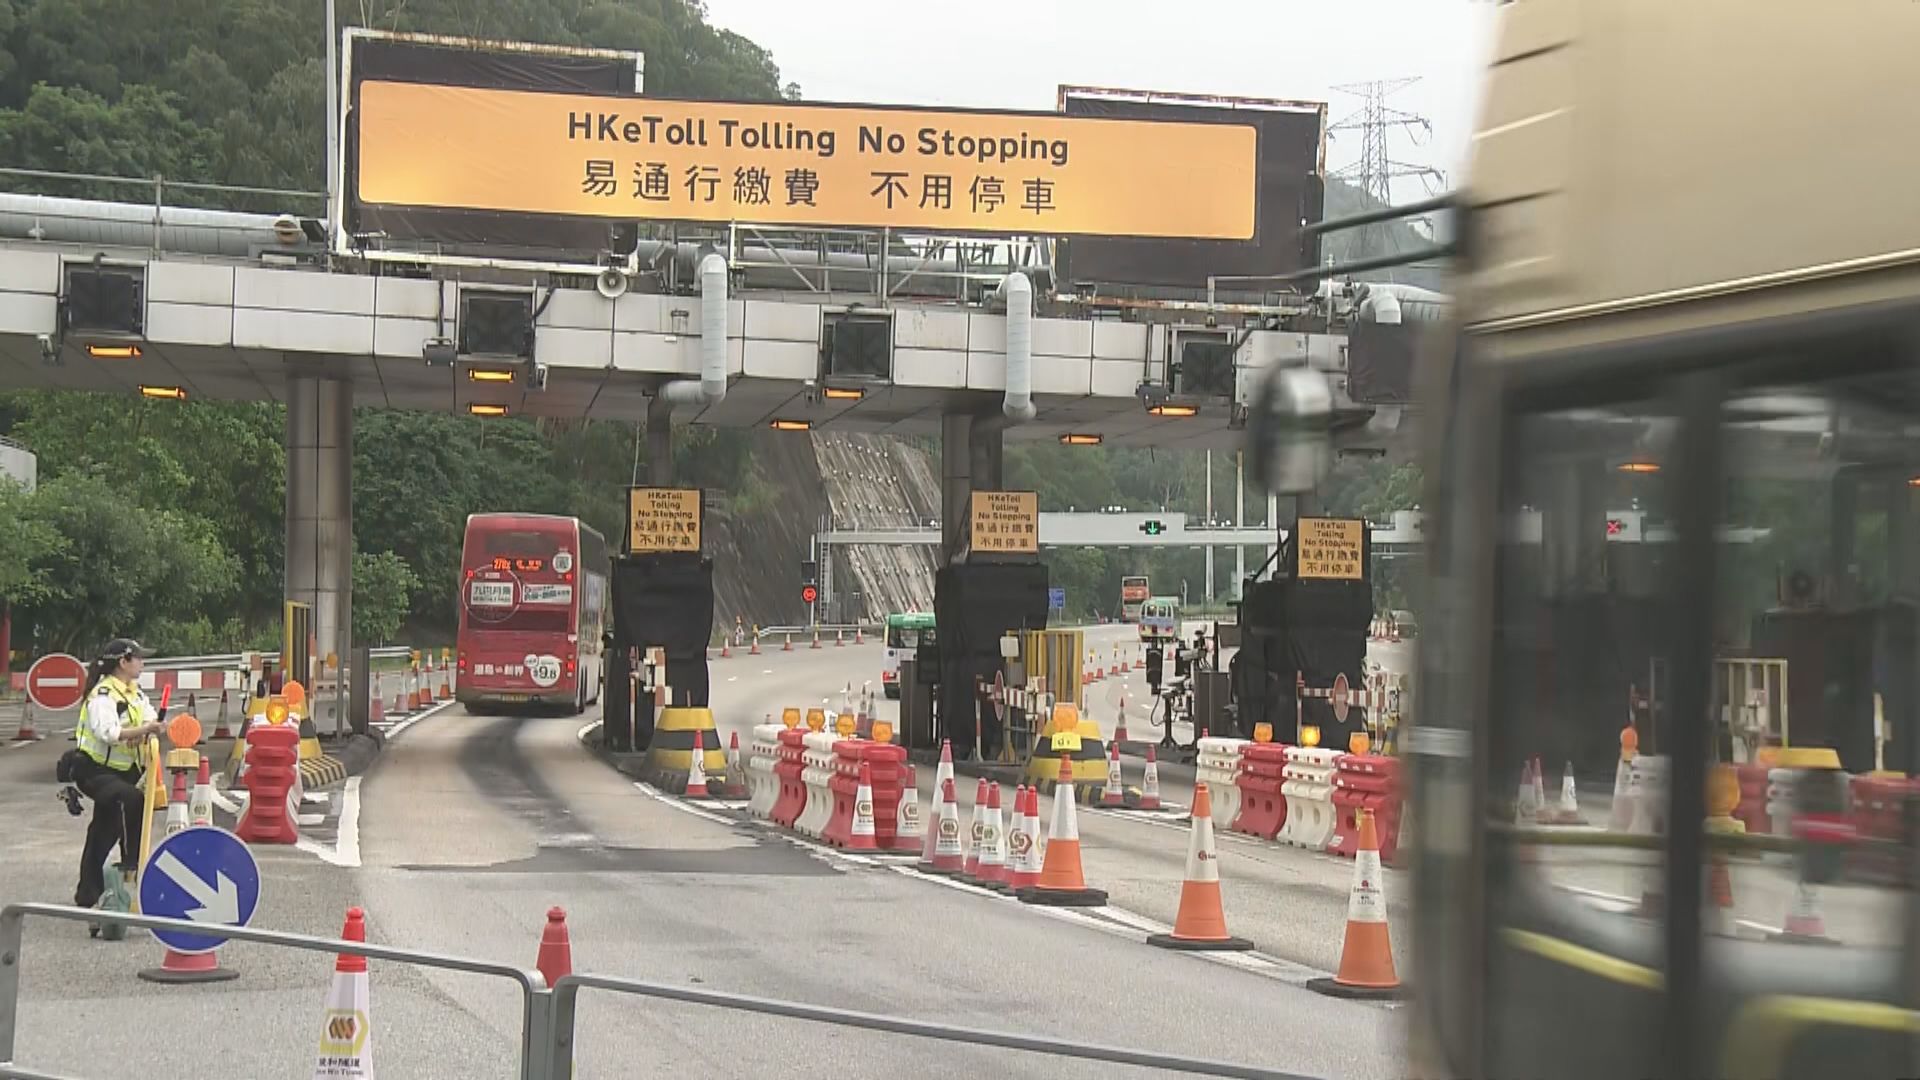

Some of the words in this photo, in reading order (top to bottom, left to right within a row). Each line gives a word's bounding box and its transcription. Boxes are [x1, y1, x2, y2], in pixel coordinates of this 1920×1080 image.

[568, 112, 708, 147] HKeToll
[719, 120, 836, 157] Tolling
[859, 126, 905, 155] No
[917, 128, 1069, 166] Stopping
[581, 160, 820, 208] 易通行繳費
[870, 171, 1057, 215] 不用停車
[650, 500, 681, 510] Tolling
[991, 503, 1019, 512] Tolling
[653, 510, 693, 519] Stopping
[992, 512, 1031, 521] Stopping
